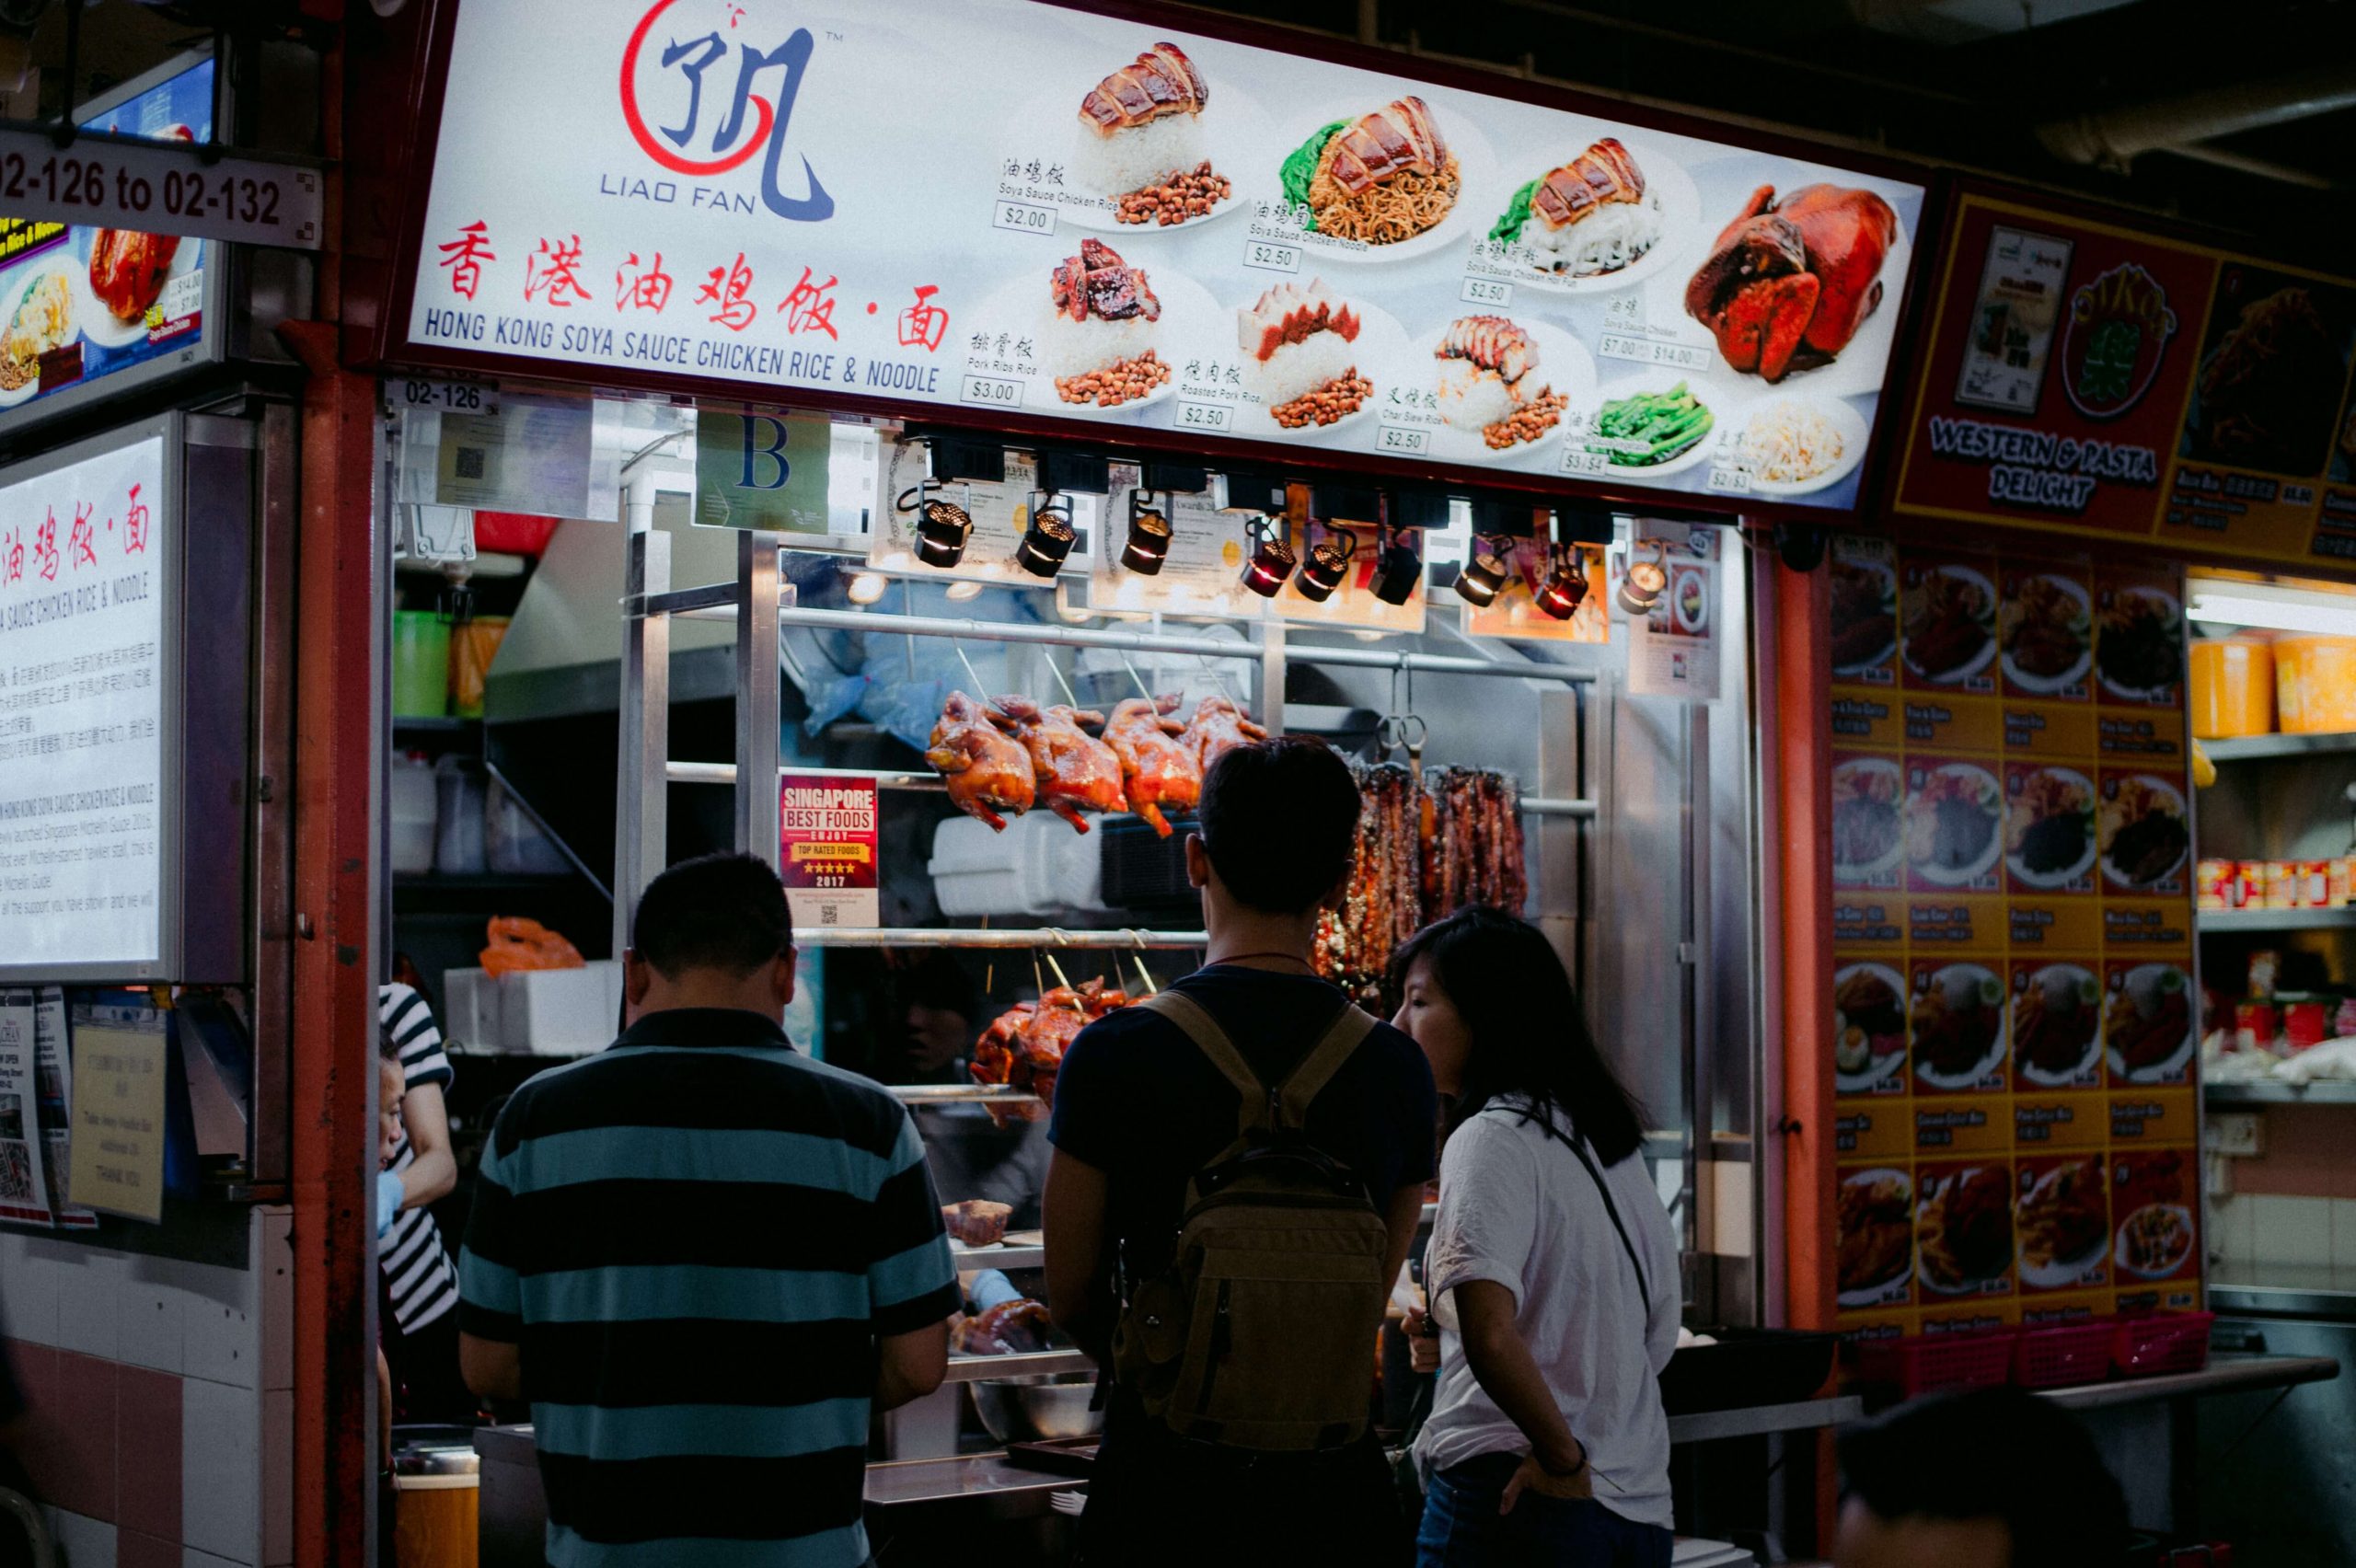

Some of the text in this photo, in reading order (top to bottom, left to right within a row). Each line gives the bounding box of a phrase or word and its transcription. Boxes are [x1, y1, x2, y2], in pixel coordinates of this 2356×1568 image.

[0, 151, 280, 225] 2-126 to 02-132
[600, 173, 755, 214] LIAO FAN
[999, 182, 1118, 212] Soya Sauce Chicken Rice
[1005, 207, 1046, 227] $2.00
[1250, 224, 1369, 252] Soya Sauce Chicken Noodle
[1254, 248, 1292, 266] $2.50
[1488, 264, 1511, 277] Sauce
[1514, 269, 1545, 282] Chicken
[1470, 282, 1504, 301] $2.50
[425, 308, 939, 393] HONG KONG SOYA SAUCE CHICKEN RICE & NOODLE
[967, 357, 1037, 375] Pork Ribs Rice
[406, 381, 479, 409] 02-126
[973, 382, 1013, 400] $3.00
[1181, 384, 1260, 403] Roasted Pork Rice
[1185, 408, 1223, 425] $2.50
[1383, 409, 1400, 420] Char
[1426, 414, 1442, 425] Rice
[1386, 432, 1421, 448] $2.50
[1930, 415, 2156, 482] WESTERN & PASTA
[734, 414, 790, 490] B
[1988, 463, 2096, 509] DELIGHT
[8, 600, 34, 631] SAUCE
[37, 590, 73, 624] CHICKEN
[77, 584, 97, 614] RICE
[113, 571, 148, 605] NOODLE
[784, 788, 874, 809] SINGAPORE
[787, 811, 870, 828] BEST FOODS
[811, 830, 848, 841] ENJOY
[799, 846, 860, 855] TOP RATED FOODS
[816, 876, 845, 887] 2017
